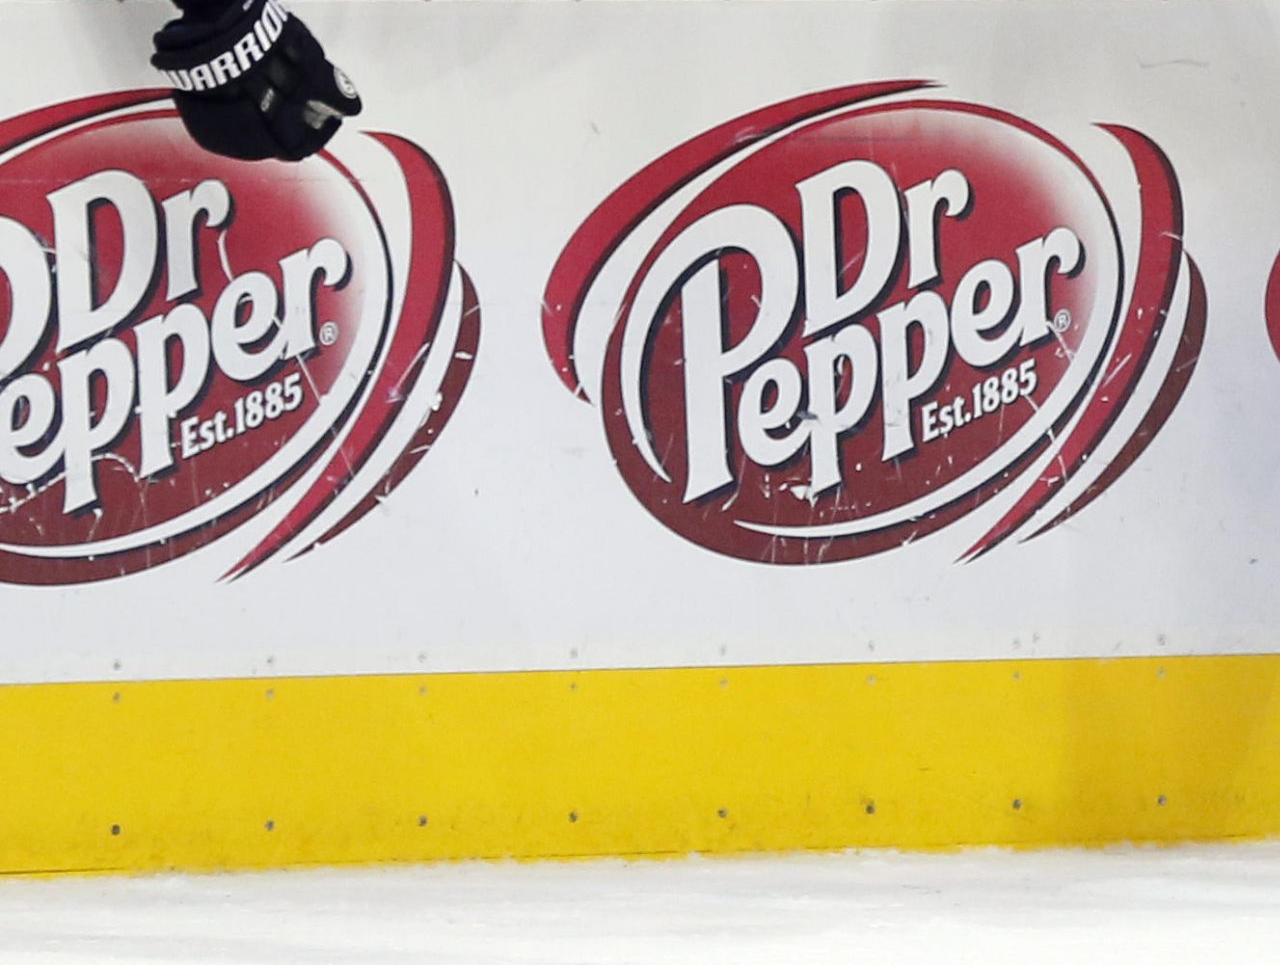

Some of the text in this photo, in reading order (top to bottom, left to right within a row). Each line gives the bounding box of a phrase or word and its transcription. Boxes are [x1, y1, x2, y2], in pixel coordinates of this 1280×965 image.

[0, 215, 349, 515] epper
[45, 168, 232, 355] Dr
[622, 202, 1081, 504] Pepper
[796, 158, 970, 338] Dr
